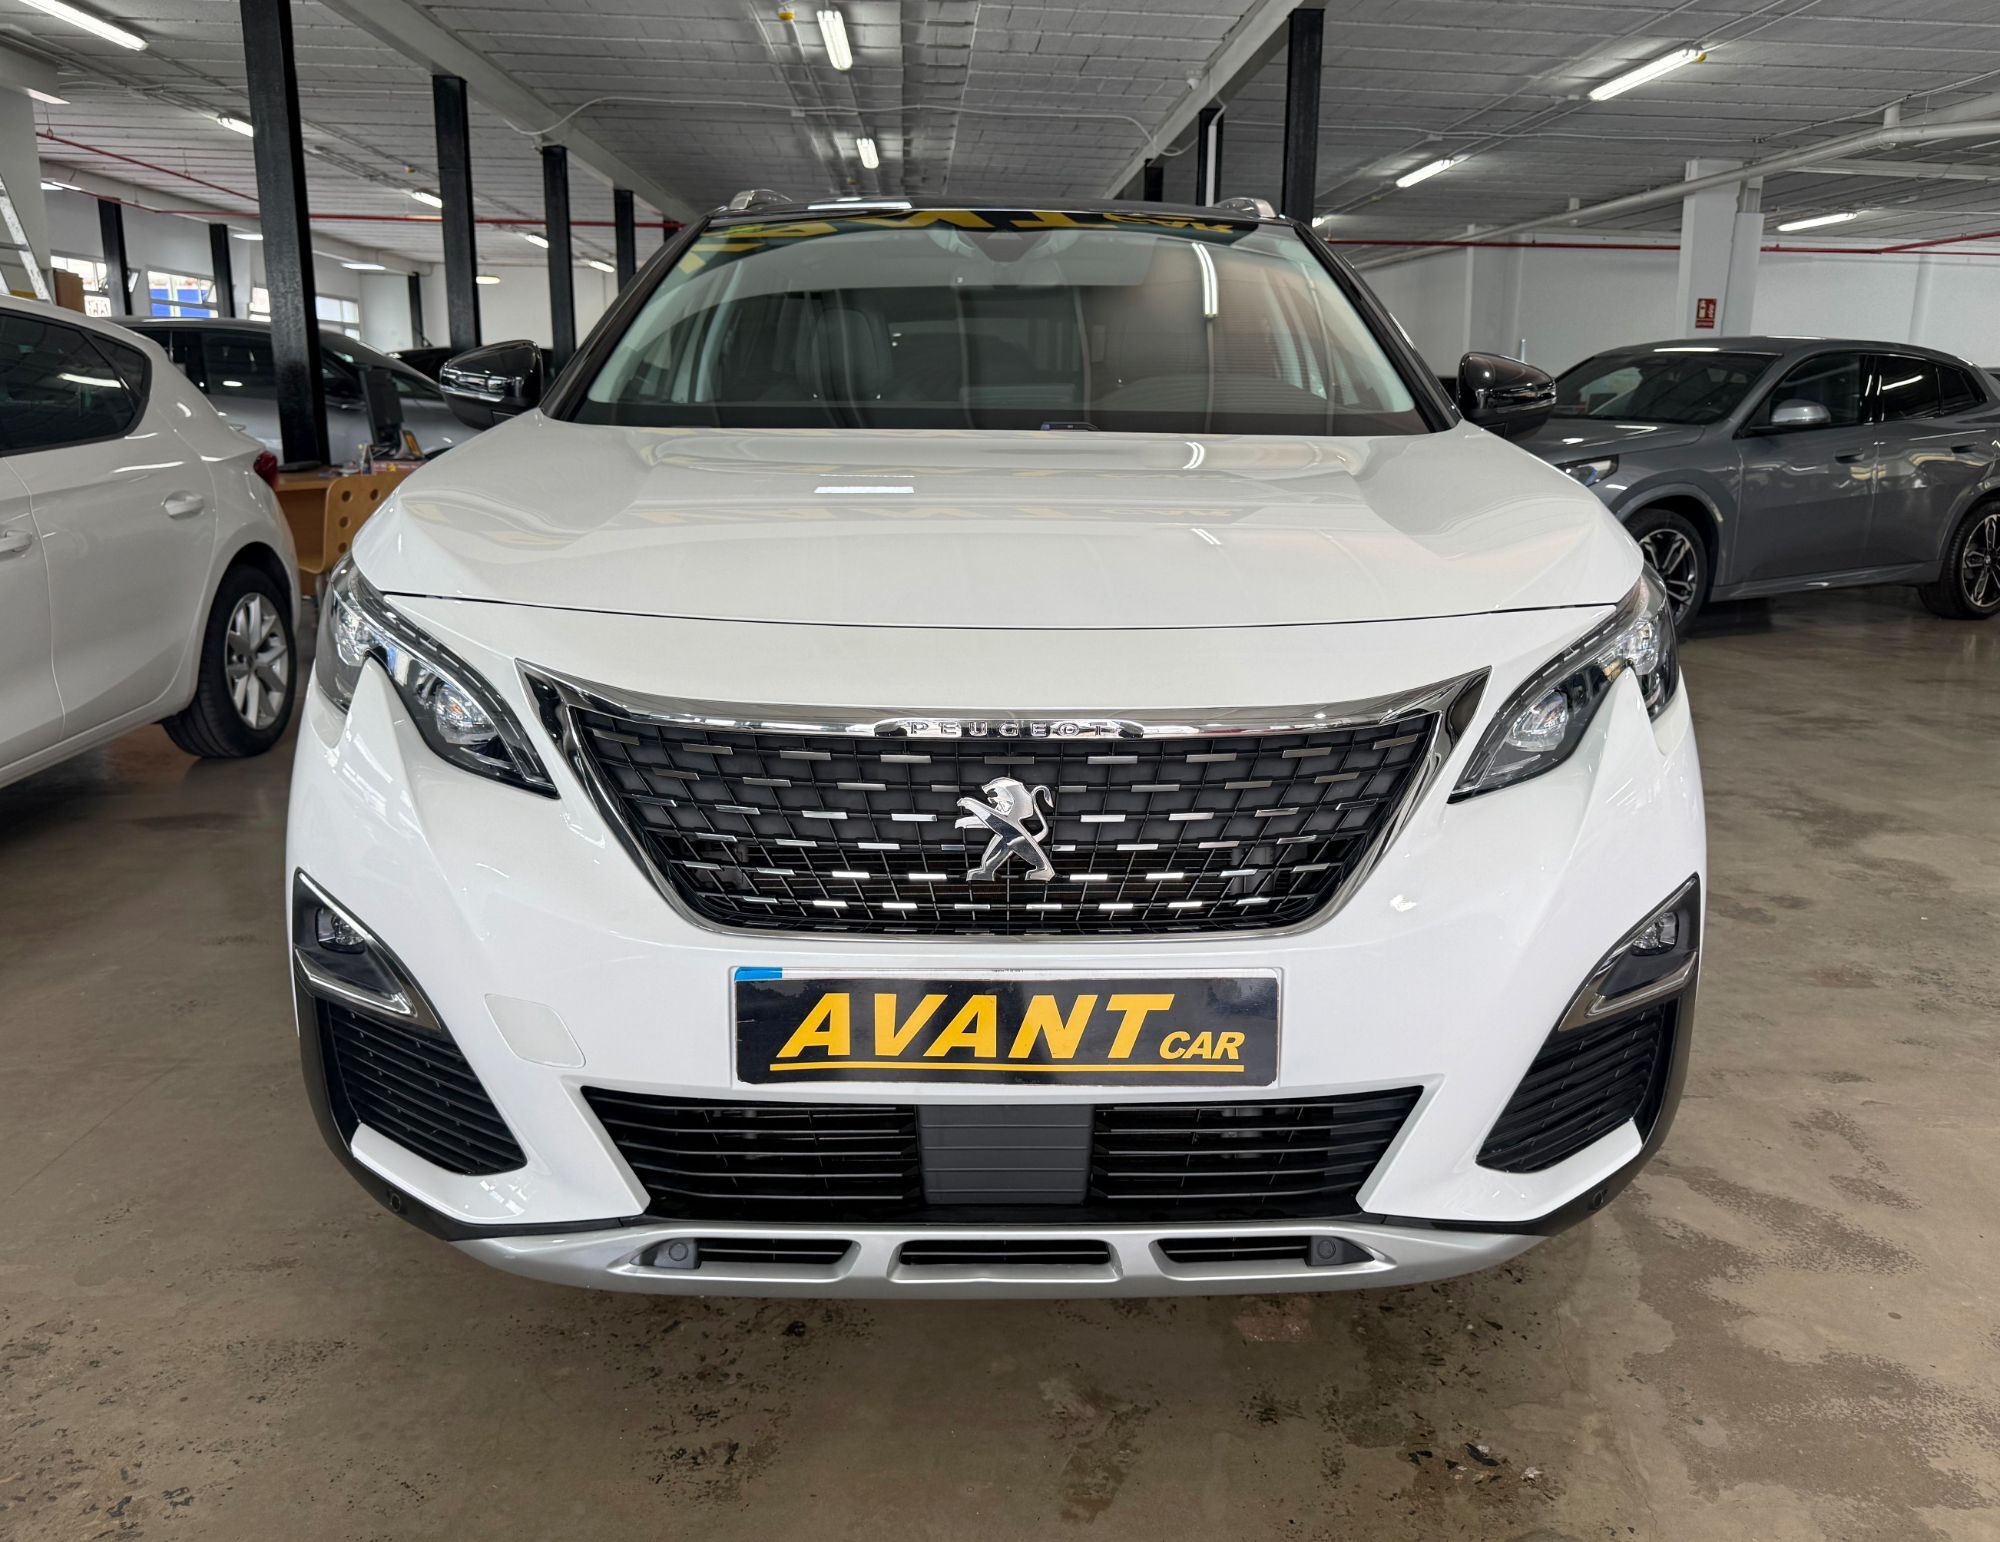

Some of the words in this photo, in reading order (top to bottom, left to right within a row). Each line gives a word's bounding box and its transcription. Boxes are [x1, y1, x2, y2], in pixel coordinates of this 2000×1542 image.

[908, 720, 1108, 737] PEUGEOT
[775, 992, 1175, 1059] AVANT
[1159, 1031, 1245, 1060] CAR
